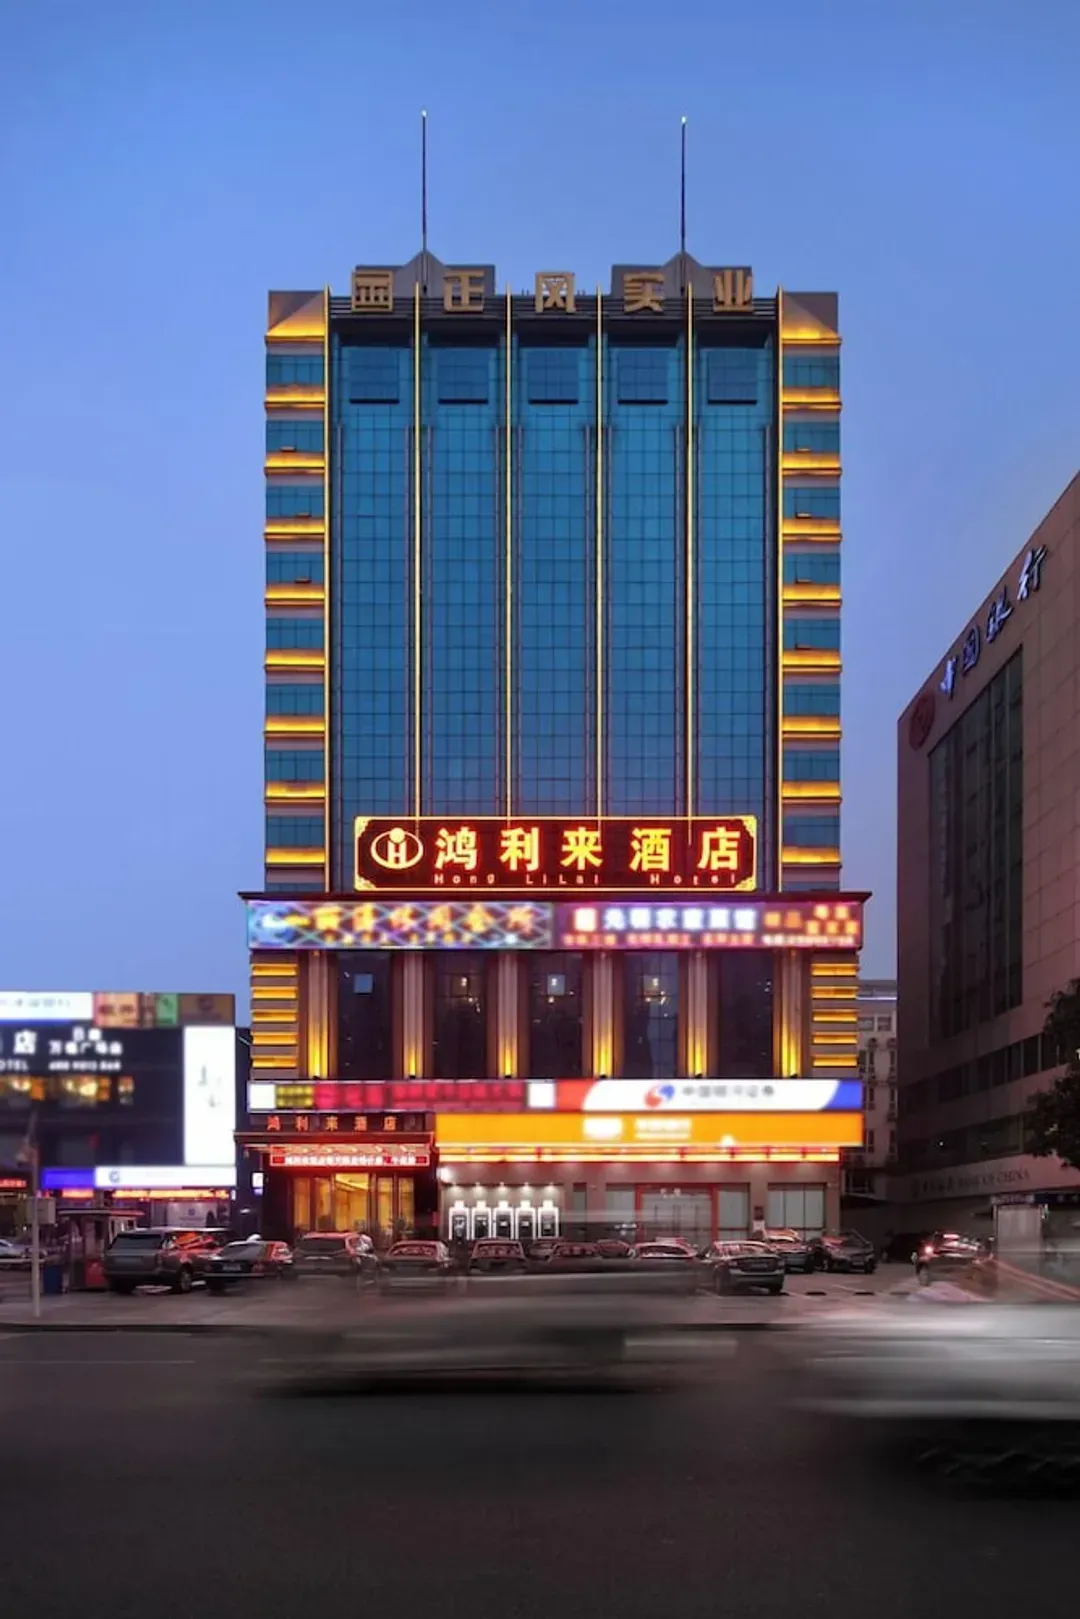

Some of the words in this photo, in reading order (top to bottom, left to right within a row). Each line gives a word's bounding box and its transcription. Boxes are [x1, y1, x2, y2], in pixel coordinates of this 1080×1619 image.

[434, 826, 741, 872] 鸿利来酒店
[434, 873, 495, 885] Hong
[650, 873, 735, 886] Hotel
